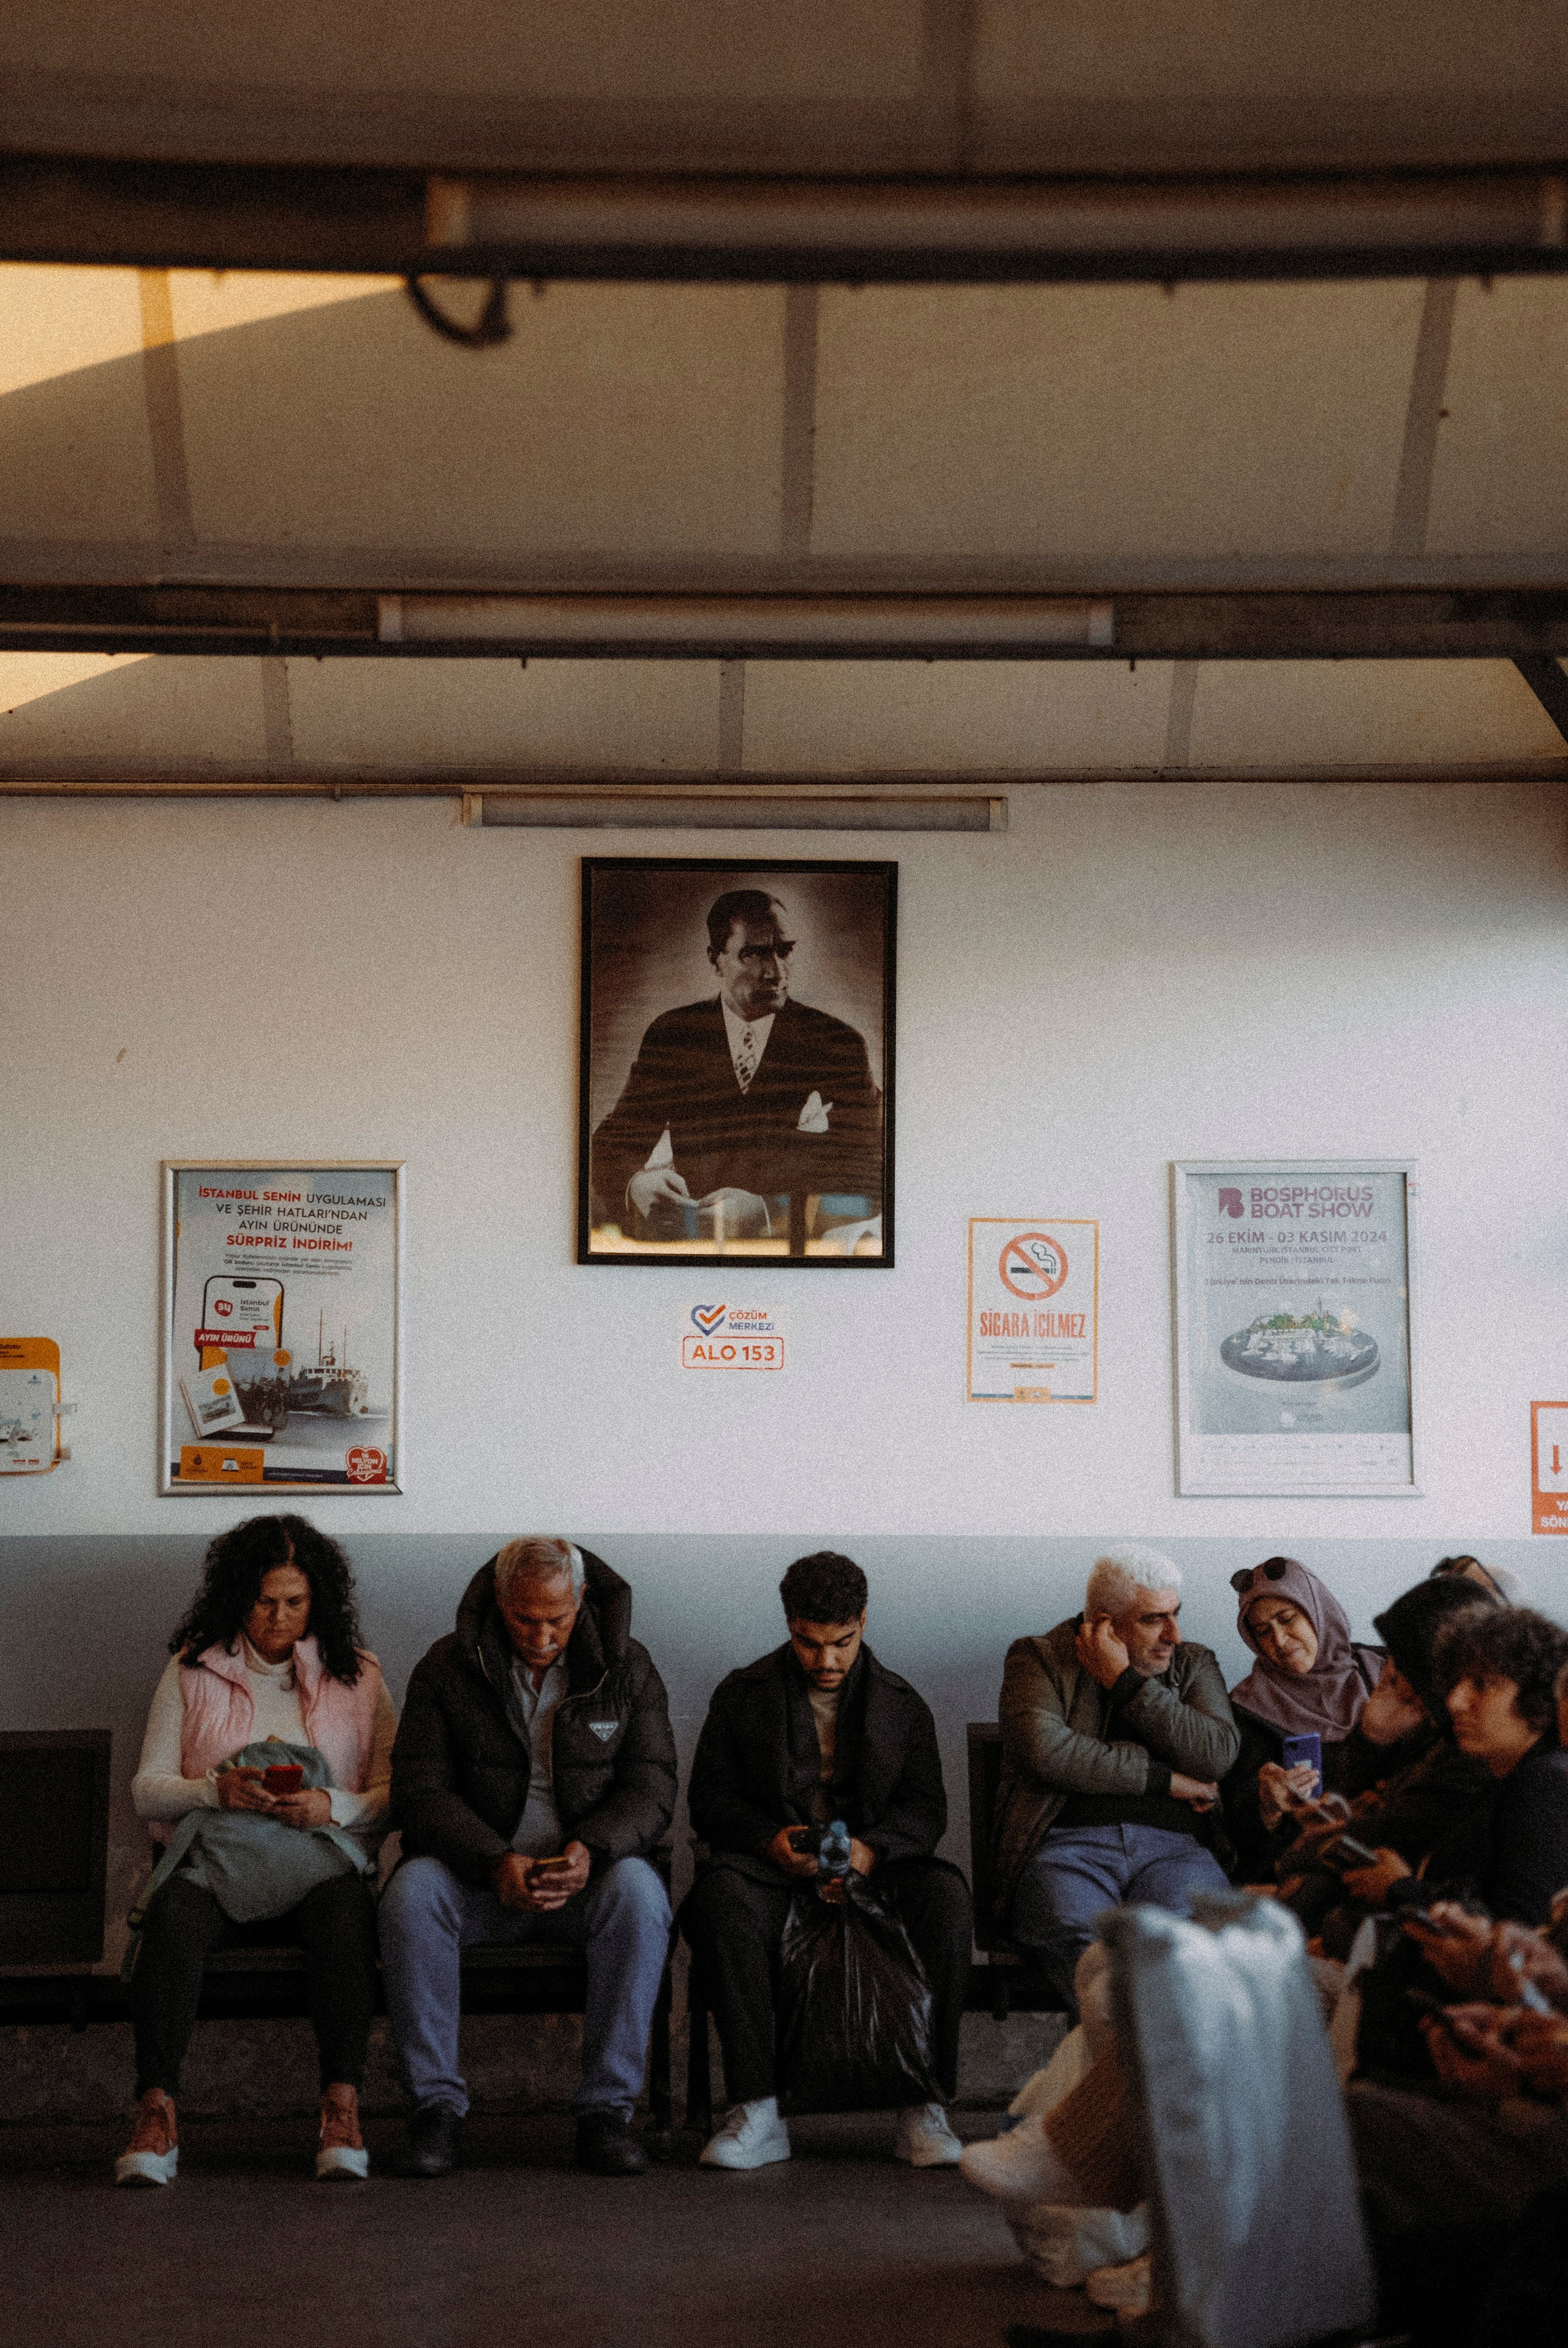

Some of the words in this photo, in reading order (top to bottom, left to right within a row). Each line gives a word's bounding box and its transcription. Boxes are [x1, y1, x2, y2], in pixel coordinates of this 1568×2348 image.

[198, 1185, 258, 1200] İSTANBUL
[263, 1190, 301, 1202] SENİN
[307, 1194, 386, 1207] UYGULAMASI
[1251, 1187, 1374, 1202] BOSPHORUS
[216, 1204, 232, 1214] VE
[237, 1204, 271, 1217] ŞEHİR
[278, 1207, 367, 1221] HATLARI'NDAN
[1251, 1202, 1304, 1218] BOAT
[1308, 1202, 1374, 1218] SHOW
[239, 1220, 268, 1230] AYIN
[273, 1220, 342, 1234] ÜRÜNÜNDE
[227, 1233, 287, 1248] SÜRPRİZ
[293, 1236, 353, 1251] İNDİRİM!
[1207, 1231, 1224, 1244] 26
[1228, 1228, 1264, 1244] EKİM
[1277, 1231, 1294, 1244] 03
[1299, 1231, 1346, 1244] KASIM
[1351, 1230, 1387, 1243] 2024
[729, 1310, 767, 1321] ÇÖZÜM
[980, 1308, 1030, 1337] SİGARA
[1033, 1308, 1086, 1340] İÇİLMEZ
[221, 1333, 252, 1343] ÜRÜNÜ
[692, 1345, 736, 1361] ALO
[742, 1345, 775, 1361] 153
[1540, 1514, 1568, 1528] SÖN
